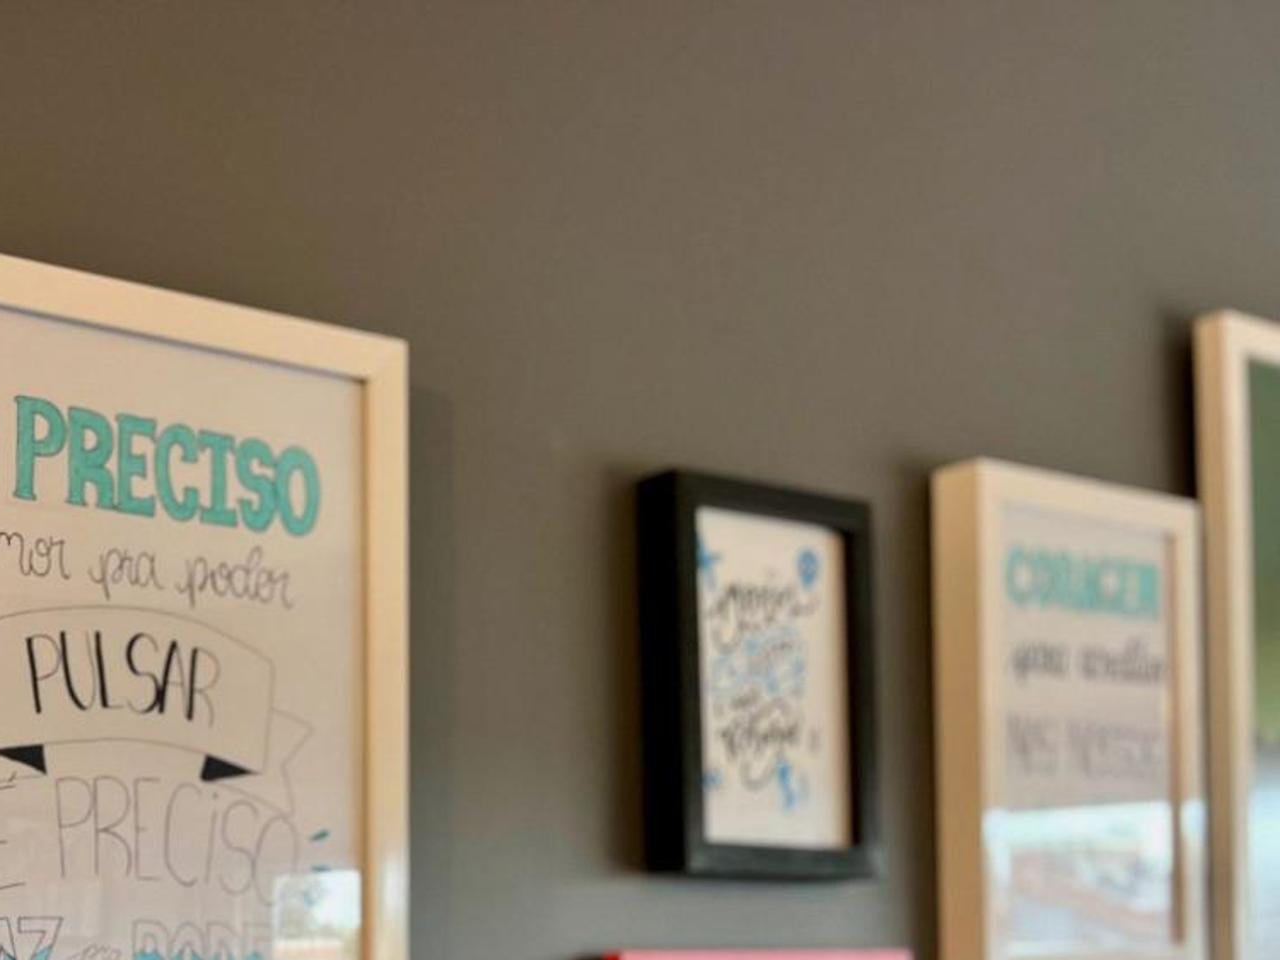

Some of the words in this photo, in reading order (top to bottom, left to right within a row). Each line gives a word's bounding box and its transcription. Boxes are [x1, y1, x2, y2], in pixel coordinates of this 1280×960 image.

[12, 394, 320, 538] PRECISO
[87, 547, 165, 600] pra
[175, 545, 294, 610] poder
[25, 630, 221, 729] PULSAR
